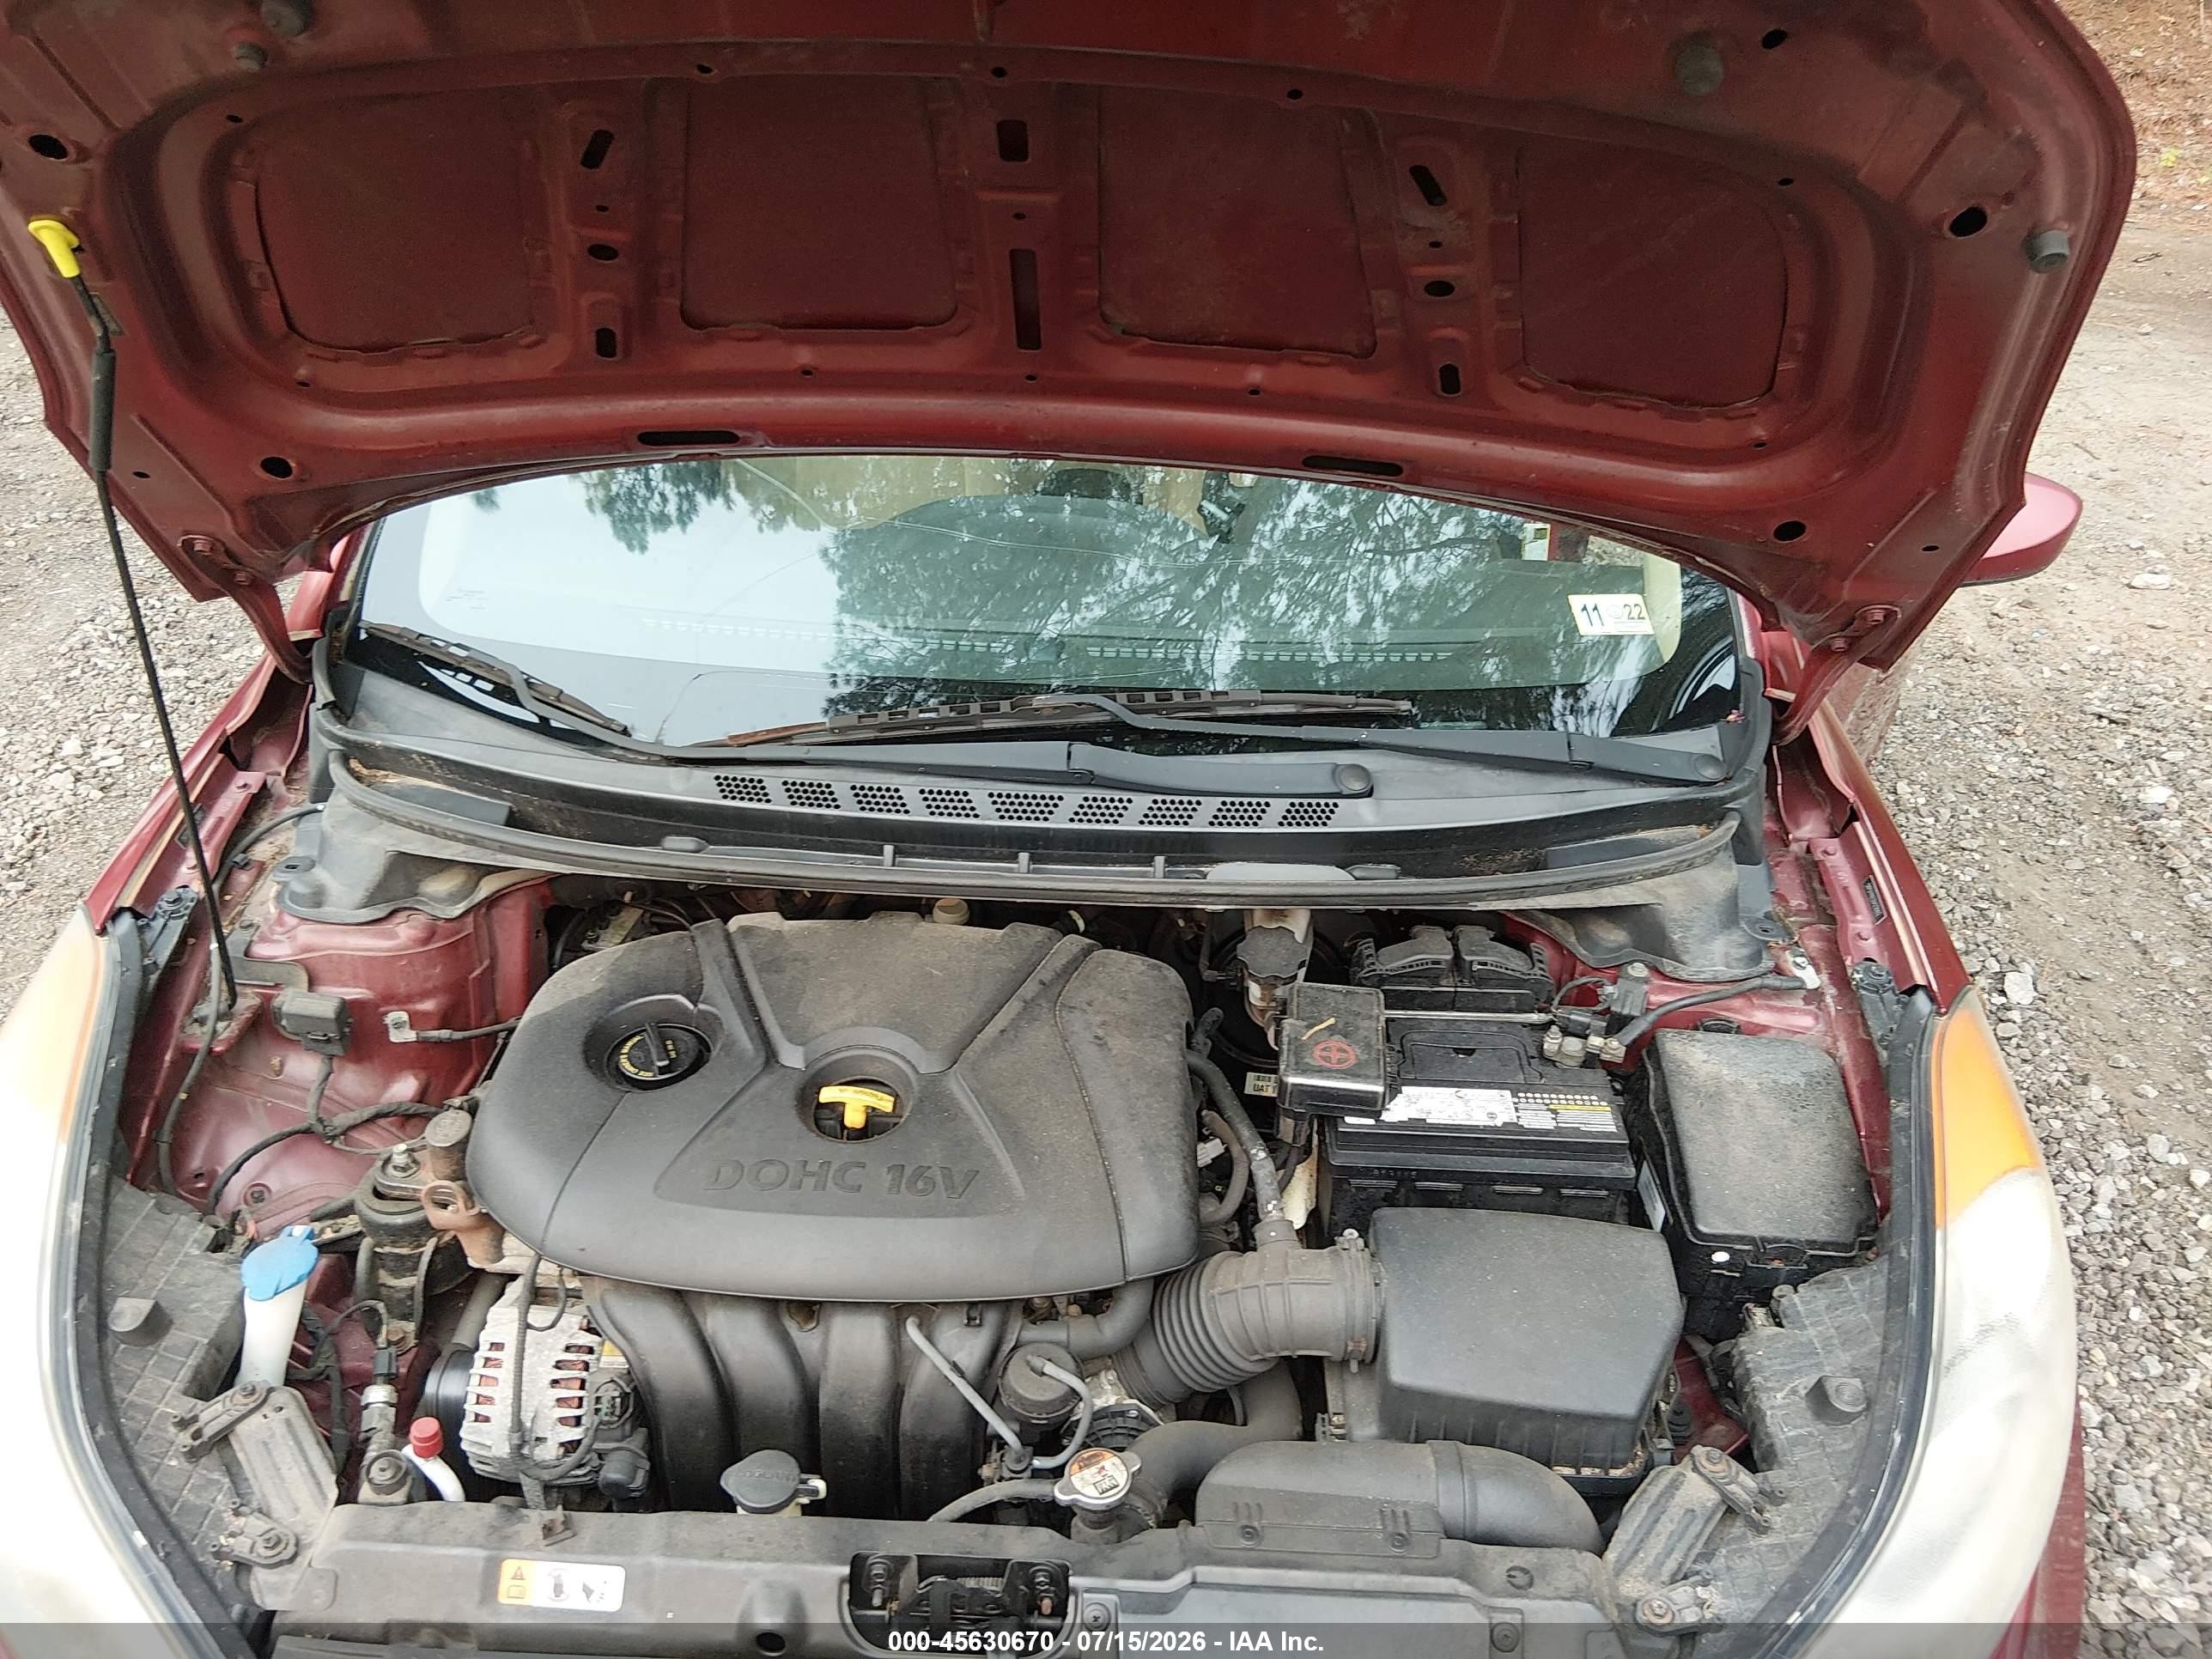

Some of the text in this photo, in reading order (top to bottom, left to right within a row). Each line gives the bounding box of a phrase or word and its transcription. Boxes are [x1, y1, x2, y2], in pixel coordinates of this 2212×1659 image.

[1581, 604, 1605, 627] 11
[1623, 604, 1646, 620] 22
[702, 1158, 980, 1200] DOHC 16V
